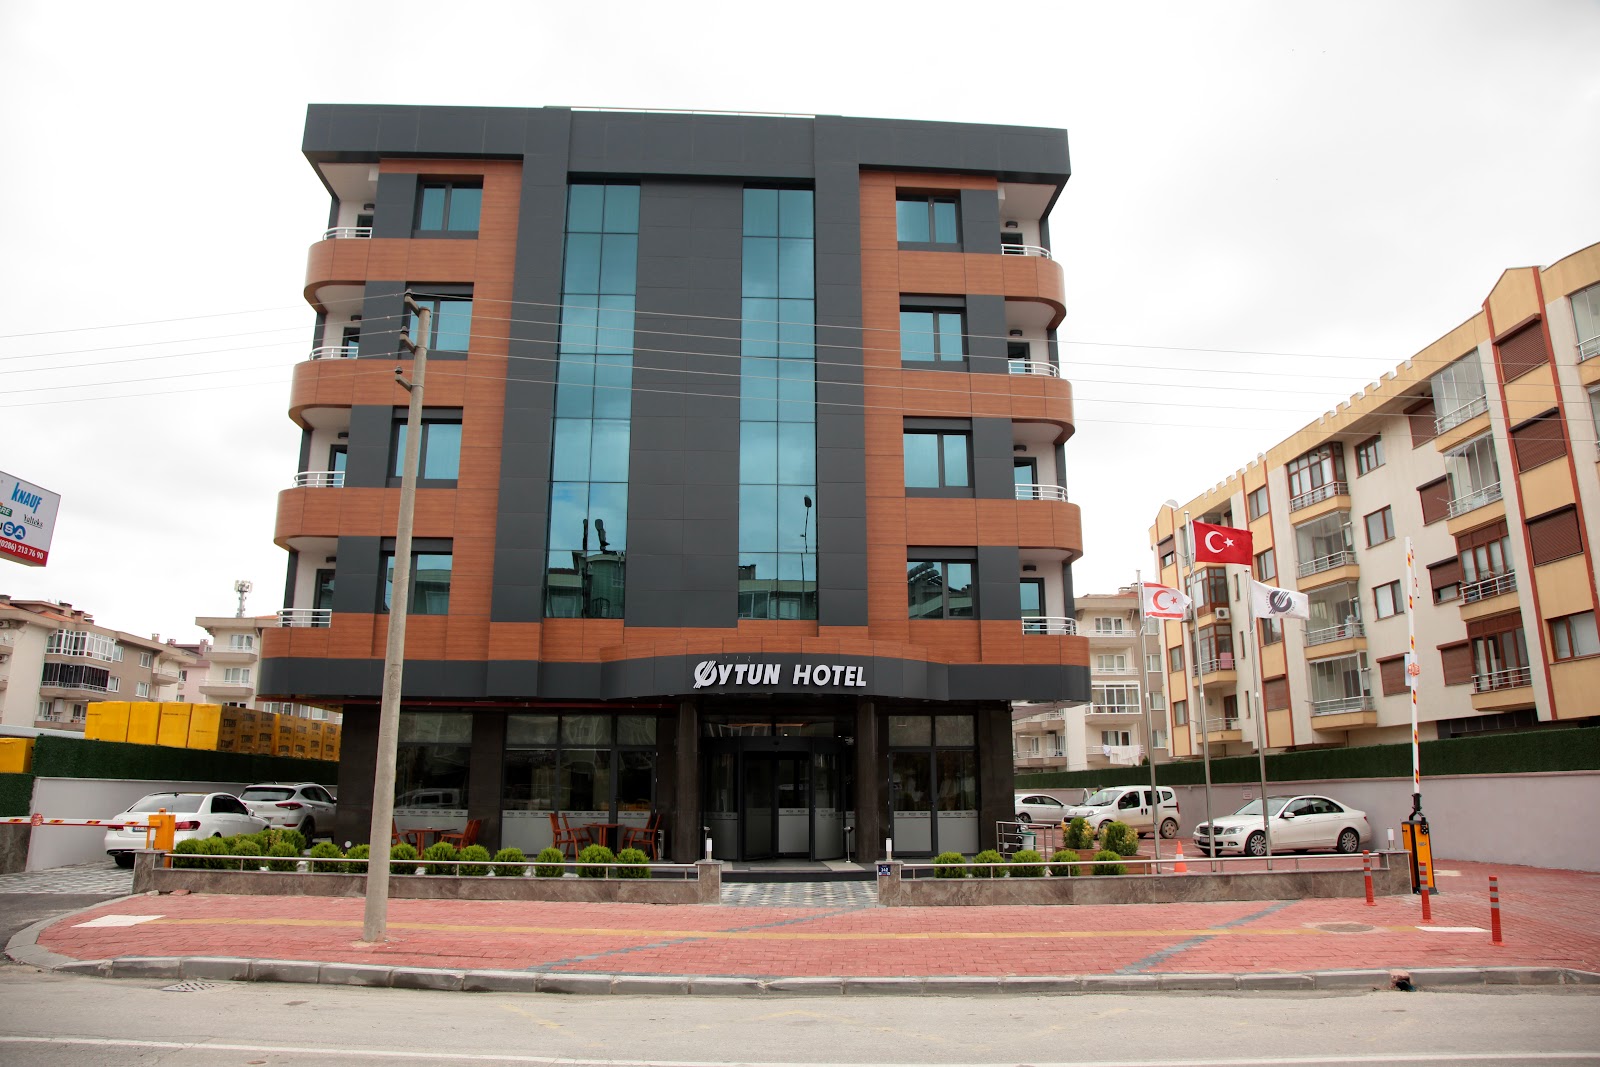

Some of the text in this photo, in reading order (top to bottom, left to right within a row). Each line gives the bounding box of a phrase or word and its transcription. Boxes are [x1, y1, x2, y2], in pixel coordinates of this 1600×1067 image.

[11, 482, 42, 514] KNAUF
[17, 545, 28, 555] 213
[29, 548, 36, 557] 76
[36, 551, 44, 560] 90
[792, 664, 867, 687] HOTEL
